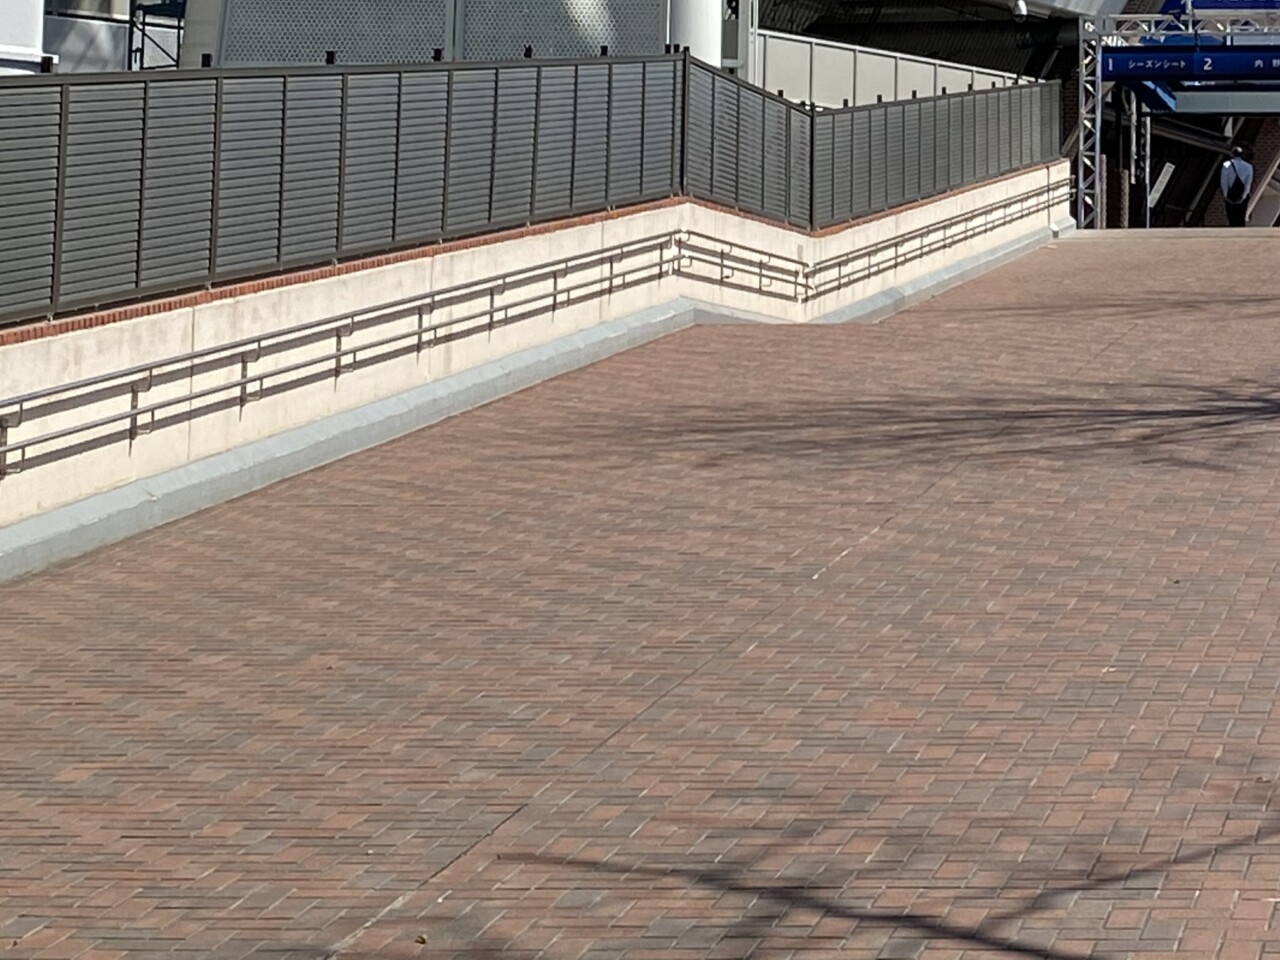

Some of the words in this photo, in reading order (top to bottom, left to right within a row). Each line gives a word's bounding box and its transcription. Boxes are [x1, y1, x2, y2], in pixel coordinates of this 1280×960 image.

[1108, 57, 1113, 72] 1
[1128, 59, 1186, 69] シーズンシート
[1203, 57, 1213, 71] 2
